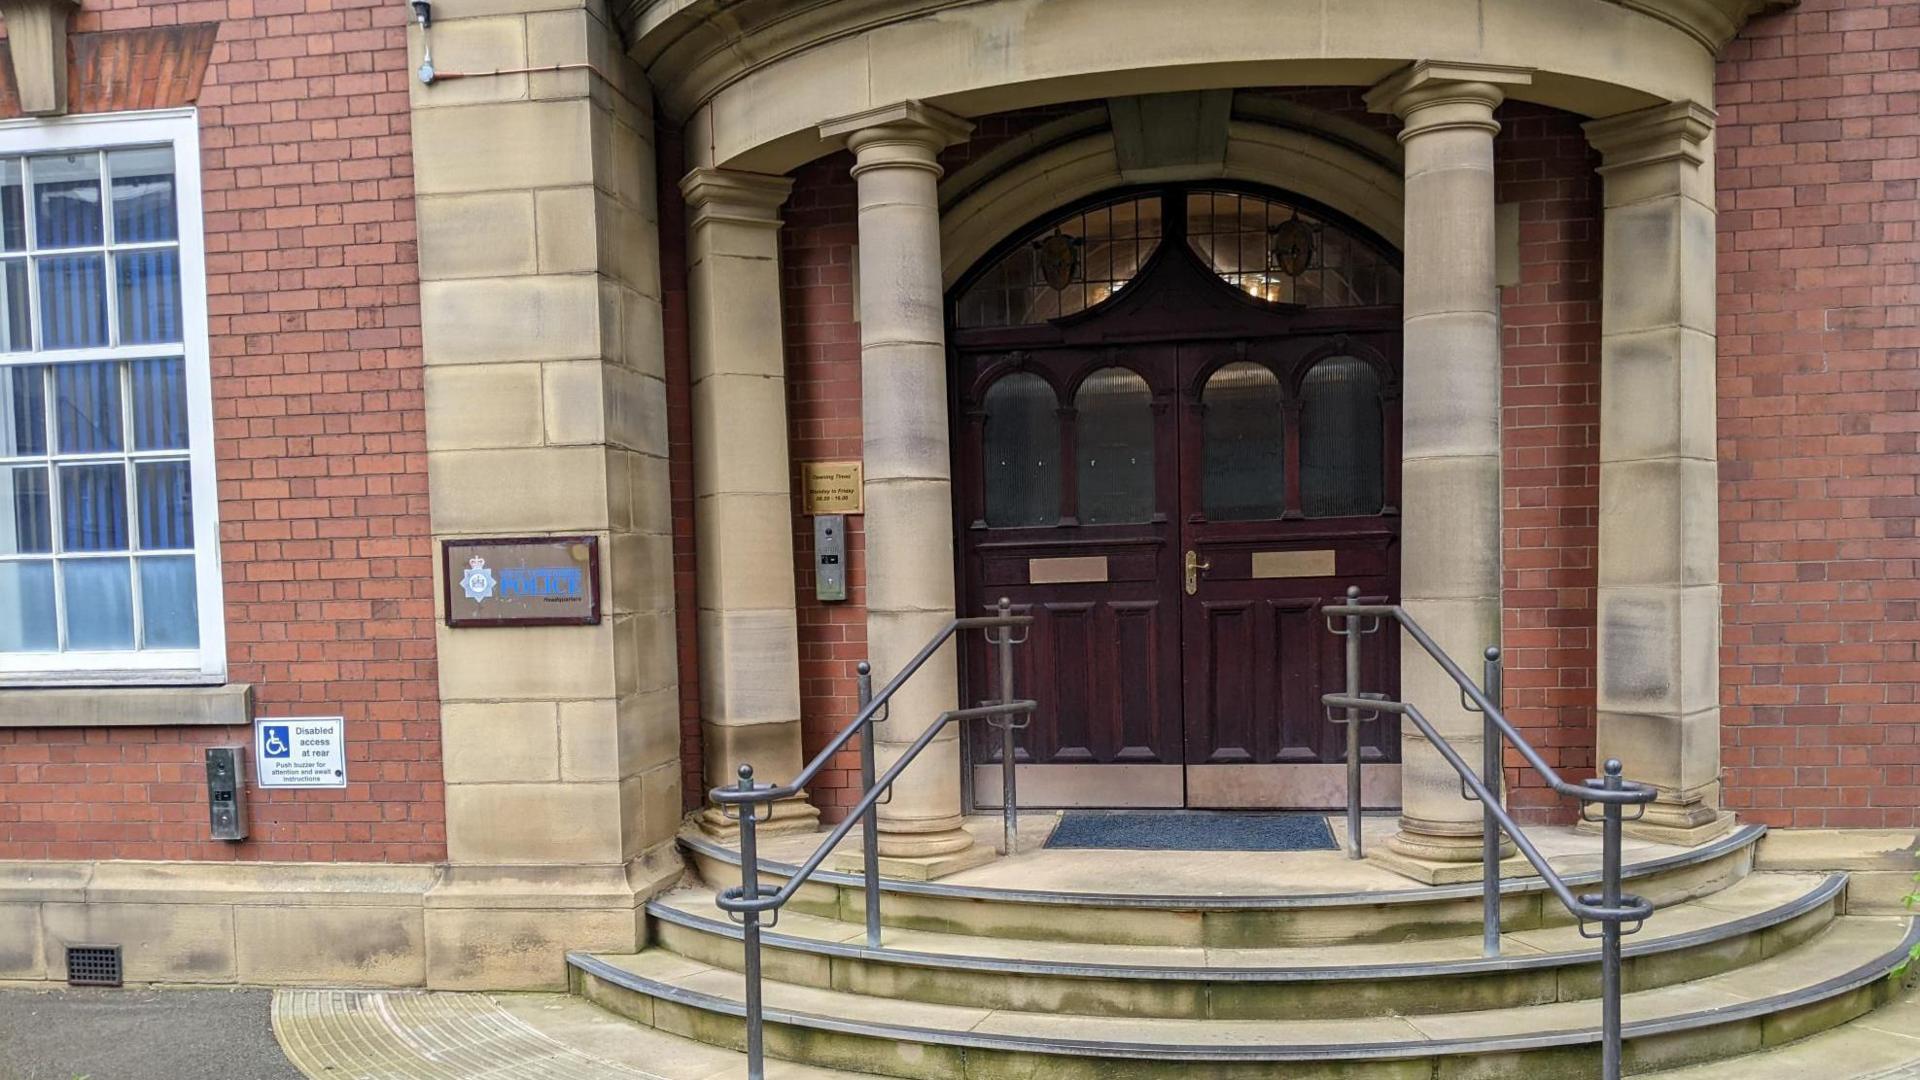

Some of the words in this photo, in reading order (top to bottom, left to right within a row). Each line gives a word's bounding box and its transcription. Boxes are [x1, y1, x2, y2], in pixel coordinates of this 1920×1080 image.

[501, 574, 581, 596] POLICE
[295, 726, 334, 735] Disabled
[302, 749, 310, 757] at
